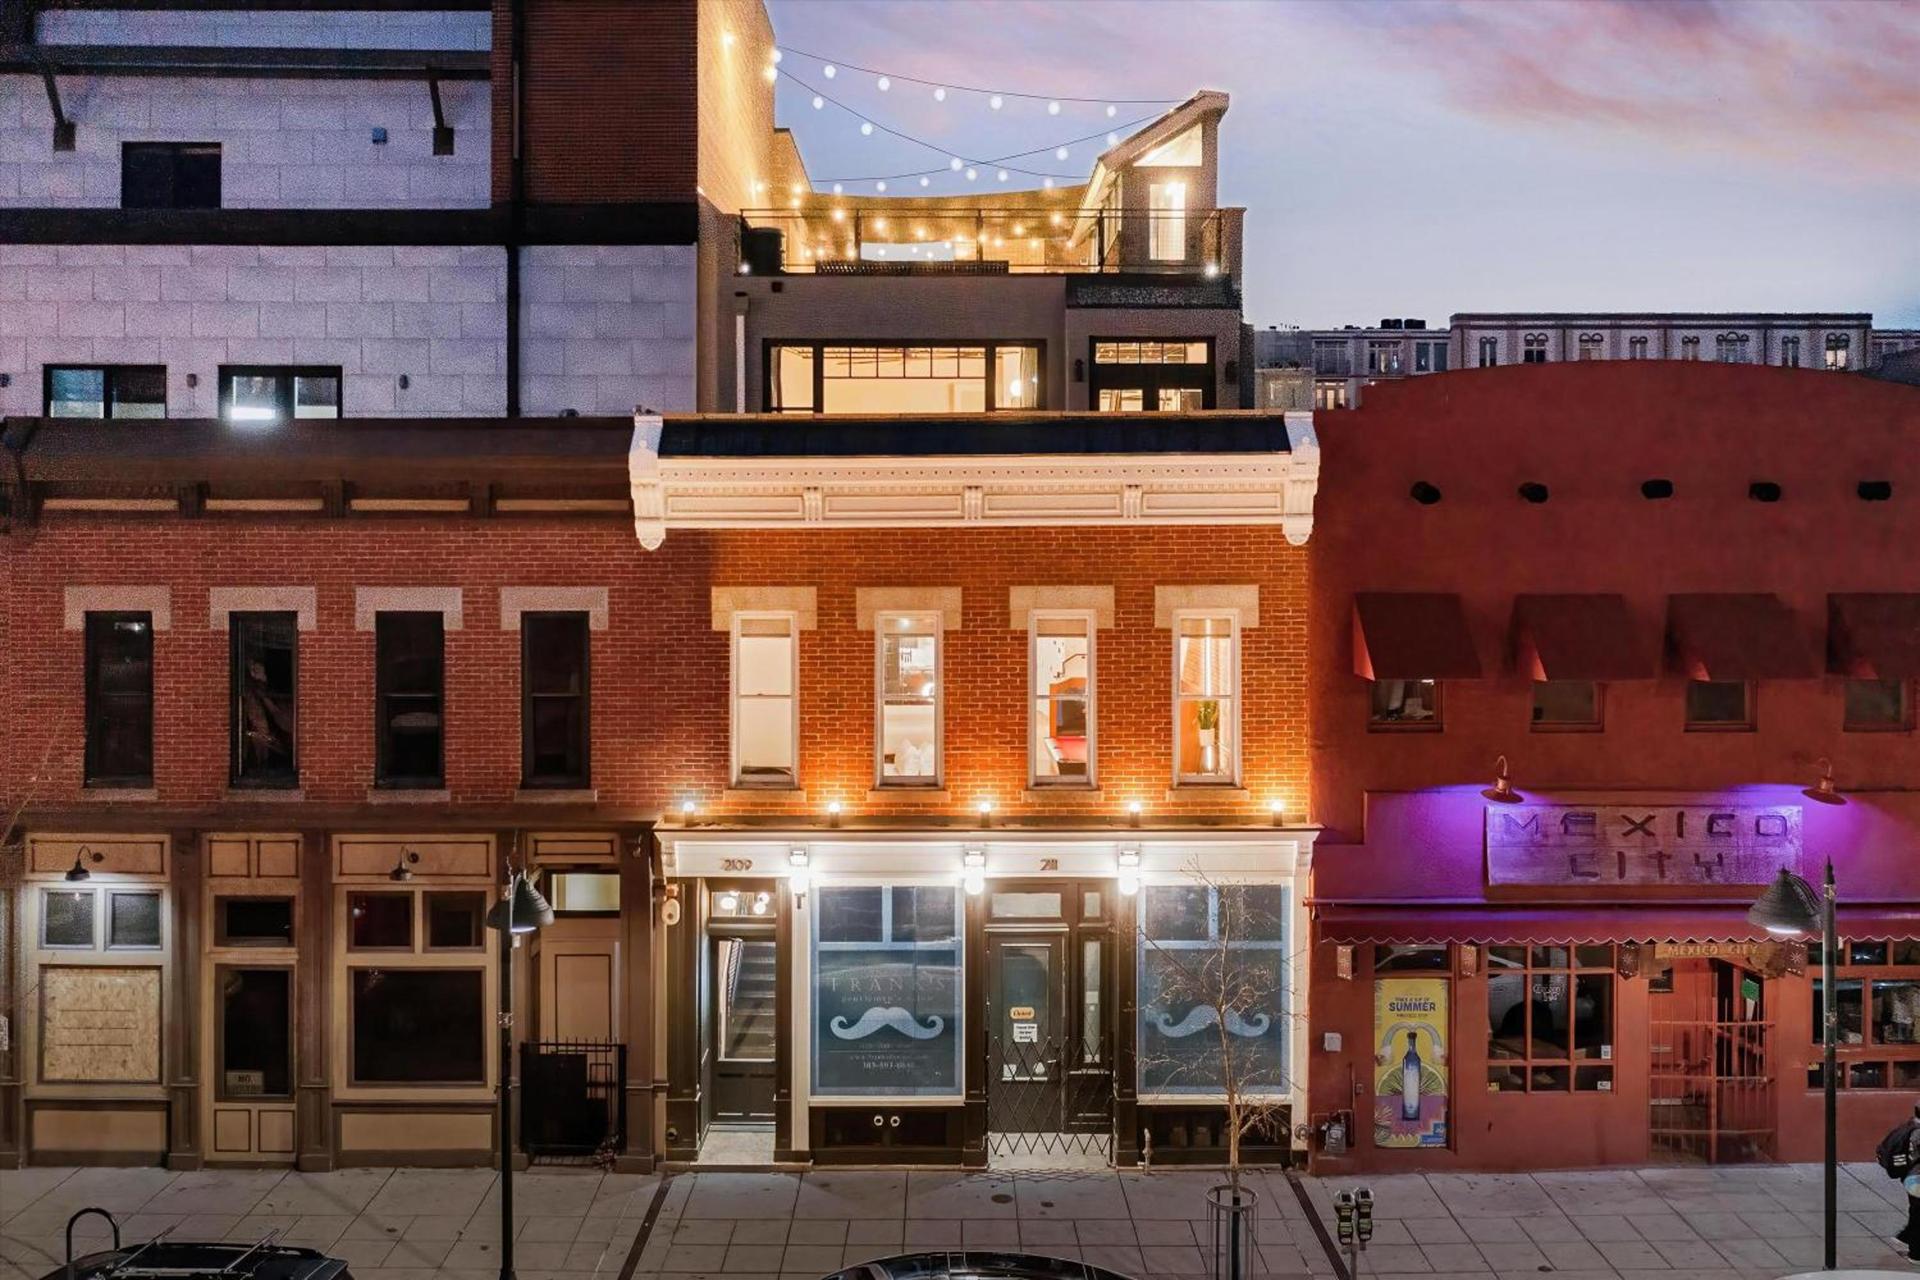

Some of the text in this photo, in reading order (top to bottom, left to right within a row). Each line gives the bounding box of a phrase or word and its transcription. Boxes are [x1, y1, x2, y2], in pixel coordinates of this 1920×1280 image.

[1503, 810, 1788, 839] MEXICO
[1568, 850, 1725, 880] CITY
[1667, 944, 1759, 957] MEXICO CITY
[1389, 1002, 1436, 1011] SUMMER
